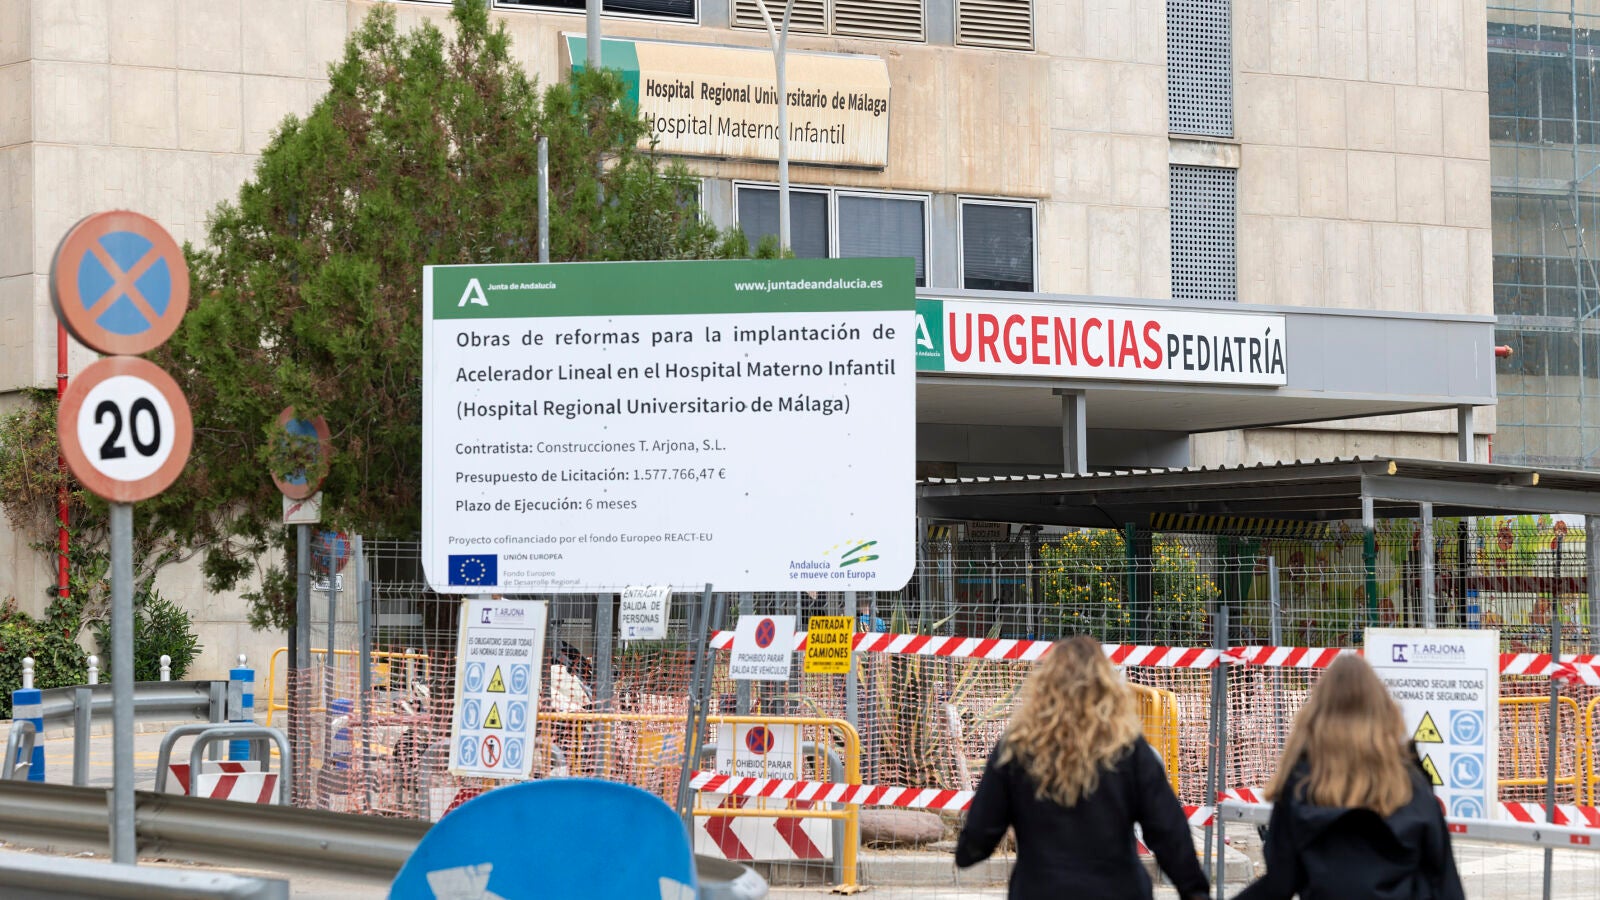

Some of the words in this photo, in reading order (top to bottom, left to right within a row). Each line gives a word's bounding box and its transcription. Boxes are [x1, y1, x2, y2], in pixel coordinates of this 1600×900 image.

[646, 78, 695, 103] Hospital
[701, 82, 751, 106] Regional
[755, 85, 828, 109] Univrsitario
[831, 91, 846, 110] de
[848, 93, 887, 117] Málaga
[645, 112, 713, 139] Hospital
[789, 121, 846, 145] Infantil
[487, 283, 508, 291] Junta
[509, 282, 519, 290] de
[519, 281, 556, 290] Andalucía
[734, 278, 884, 293] www.juntadeandalucia.es
[457, 331, 510, 347] Obras
[522, 330, 543, 345] de
[556, 329, 639, 346] reformas
[652, 331, 692, 347] para
[706, 326, 721, 342] la
[734, 323, 860, 345] implantación
[873, 324, 895, 339] de
[948, 312, 1164, 370] URGENCIAS
[1167, 326, 1286, 375] PEDIATRÍA
[456, 365, 553, 382] Acelerador
[559, 363, 612, 380] Lineal
[617, 367, 638, 379] en
[644, 362, 660, 378] el
[666, 361, 741, 382] Hospital
[748, 362, 822, 376] Materno
[829, 359, 895, 376] Infantil
[457, 400, 538, 420] (Hospital
[544, 398, 621, 419] Regional
[627, 397, 745, 414] Universitario
[751, 396, 772, 412] de
[779, 394, 849, 415] Málaga)
[95, 397, 161, 460] 20
[456, 442, 532, 454] Contratista:
[537, 441, 635, 453] Construcciones
[639, 441, 648, 451] T.
[653, 440, 698, 454] Arjona,
[703, 440, 725, 450] S.L.
[456, 472, 537, 484] Presupuesto
[542, 470, 557, 481] de
[562, 467, 628, 481] Licitación:
[634, 469, 714, 481] 1.577.766,47
[719, 468, 725, 479] €
[456, 500, 491, 511] Plazo
[495, 500, 510, 511] de
[515, 497, 581, 513] Ejecución:
[586, 499, 592, 509] 6
[597, 501, 636, 509] meses
[449, 536, 491, 546] Proyecto
[494, 535, 556, 543] cofinanciado
[560, 536, 575, 545] por
[590, 534, 617, 542] fondo
[621, 534, 661, 544] Europeo
[665, 533, 712, 541] REACT-EU
[503, 553, 528, 561] UNIÓN
[529, 553, 563, 561] EUROPEA
[526, 570, 556, 578] Europeo
[789, 571, 799, 579] se
[800, 571, 829, 579] mueve
[830, 571, 845, 579] con
[847, 569, 876, 580] Europa
[623, 589, 657, 599] ENTRADA
[622, 601, 647, 611] SALIDA
[651, 601, 661, 611] DE
[622, 613, 660, 624] PERSONAS
[810, 619, 845, 630] ENTRADA
[846, 619, 852, 630] Y
[810, 633, 837, 644] SALIDA
[839, 633, 849, 644] DE
[808, 647, 849, 658] CAMIONES
[1422, 644, 1465, 654] ARJONA
[1431, 679, 1457, 689] SEGUIR
[1458, 680, 1484, 690] TODAS
[726, 759, 765, 768] POHIBIDO
[767, 760, 793, 769] PARAR
